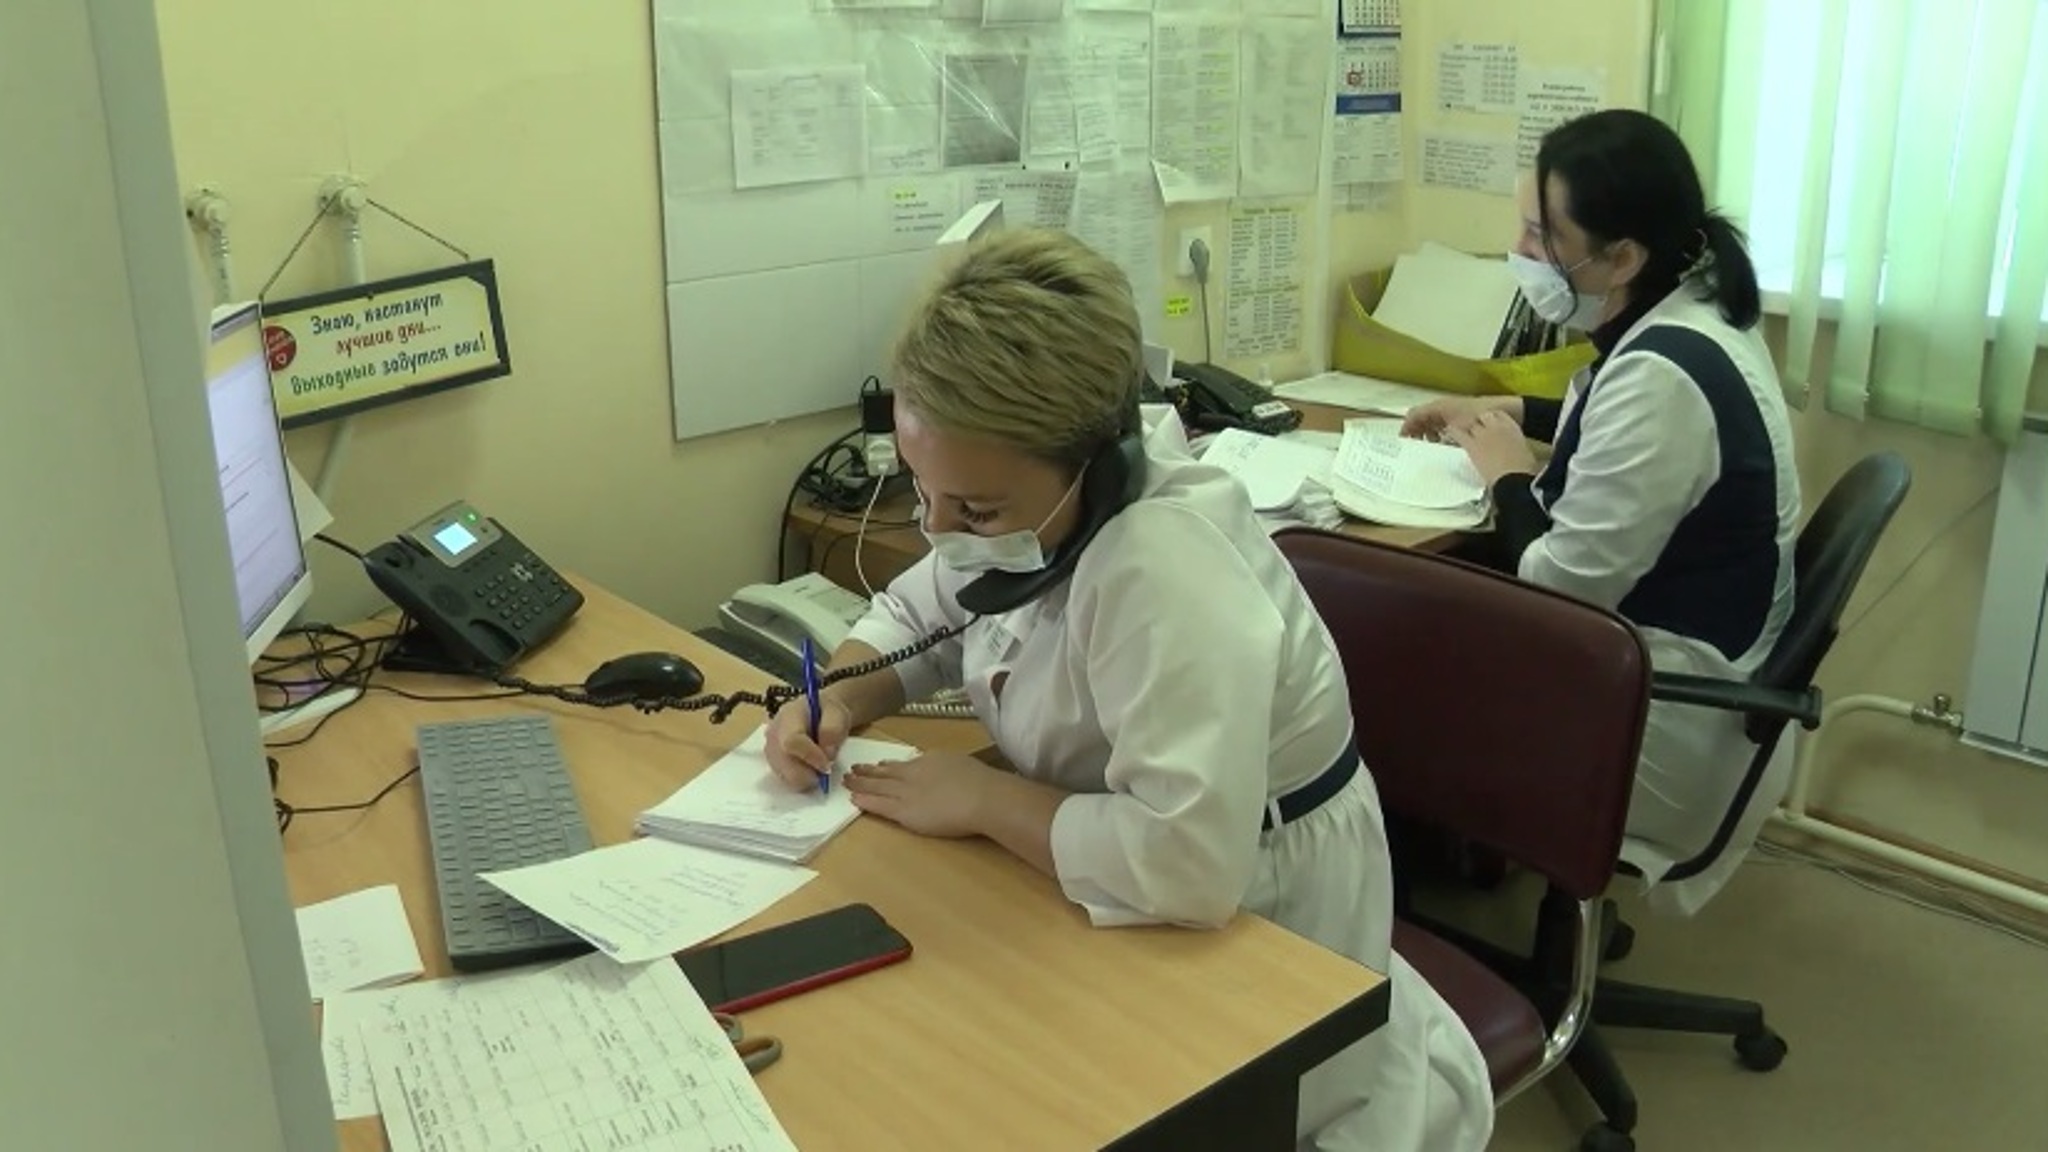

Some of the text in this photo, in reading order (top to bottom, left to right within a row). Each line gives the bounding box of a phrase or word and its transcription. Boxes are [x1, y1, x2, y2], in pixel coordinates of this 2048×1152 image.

[310, 293, 443, 335] Знаю, настанут
[336, 328, 394, 358] лучшие
[381, 347, 449, 376] зовутся
[454, 330, 486, 357] они!
